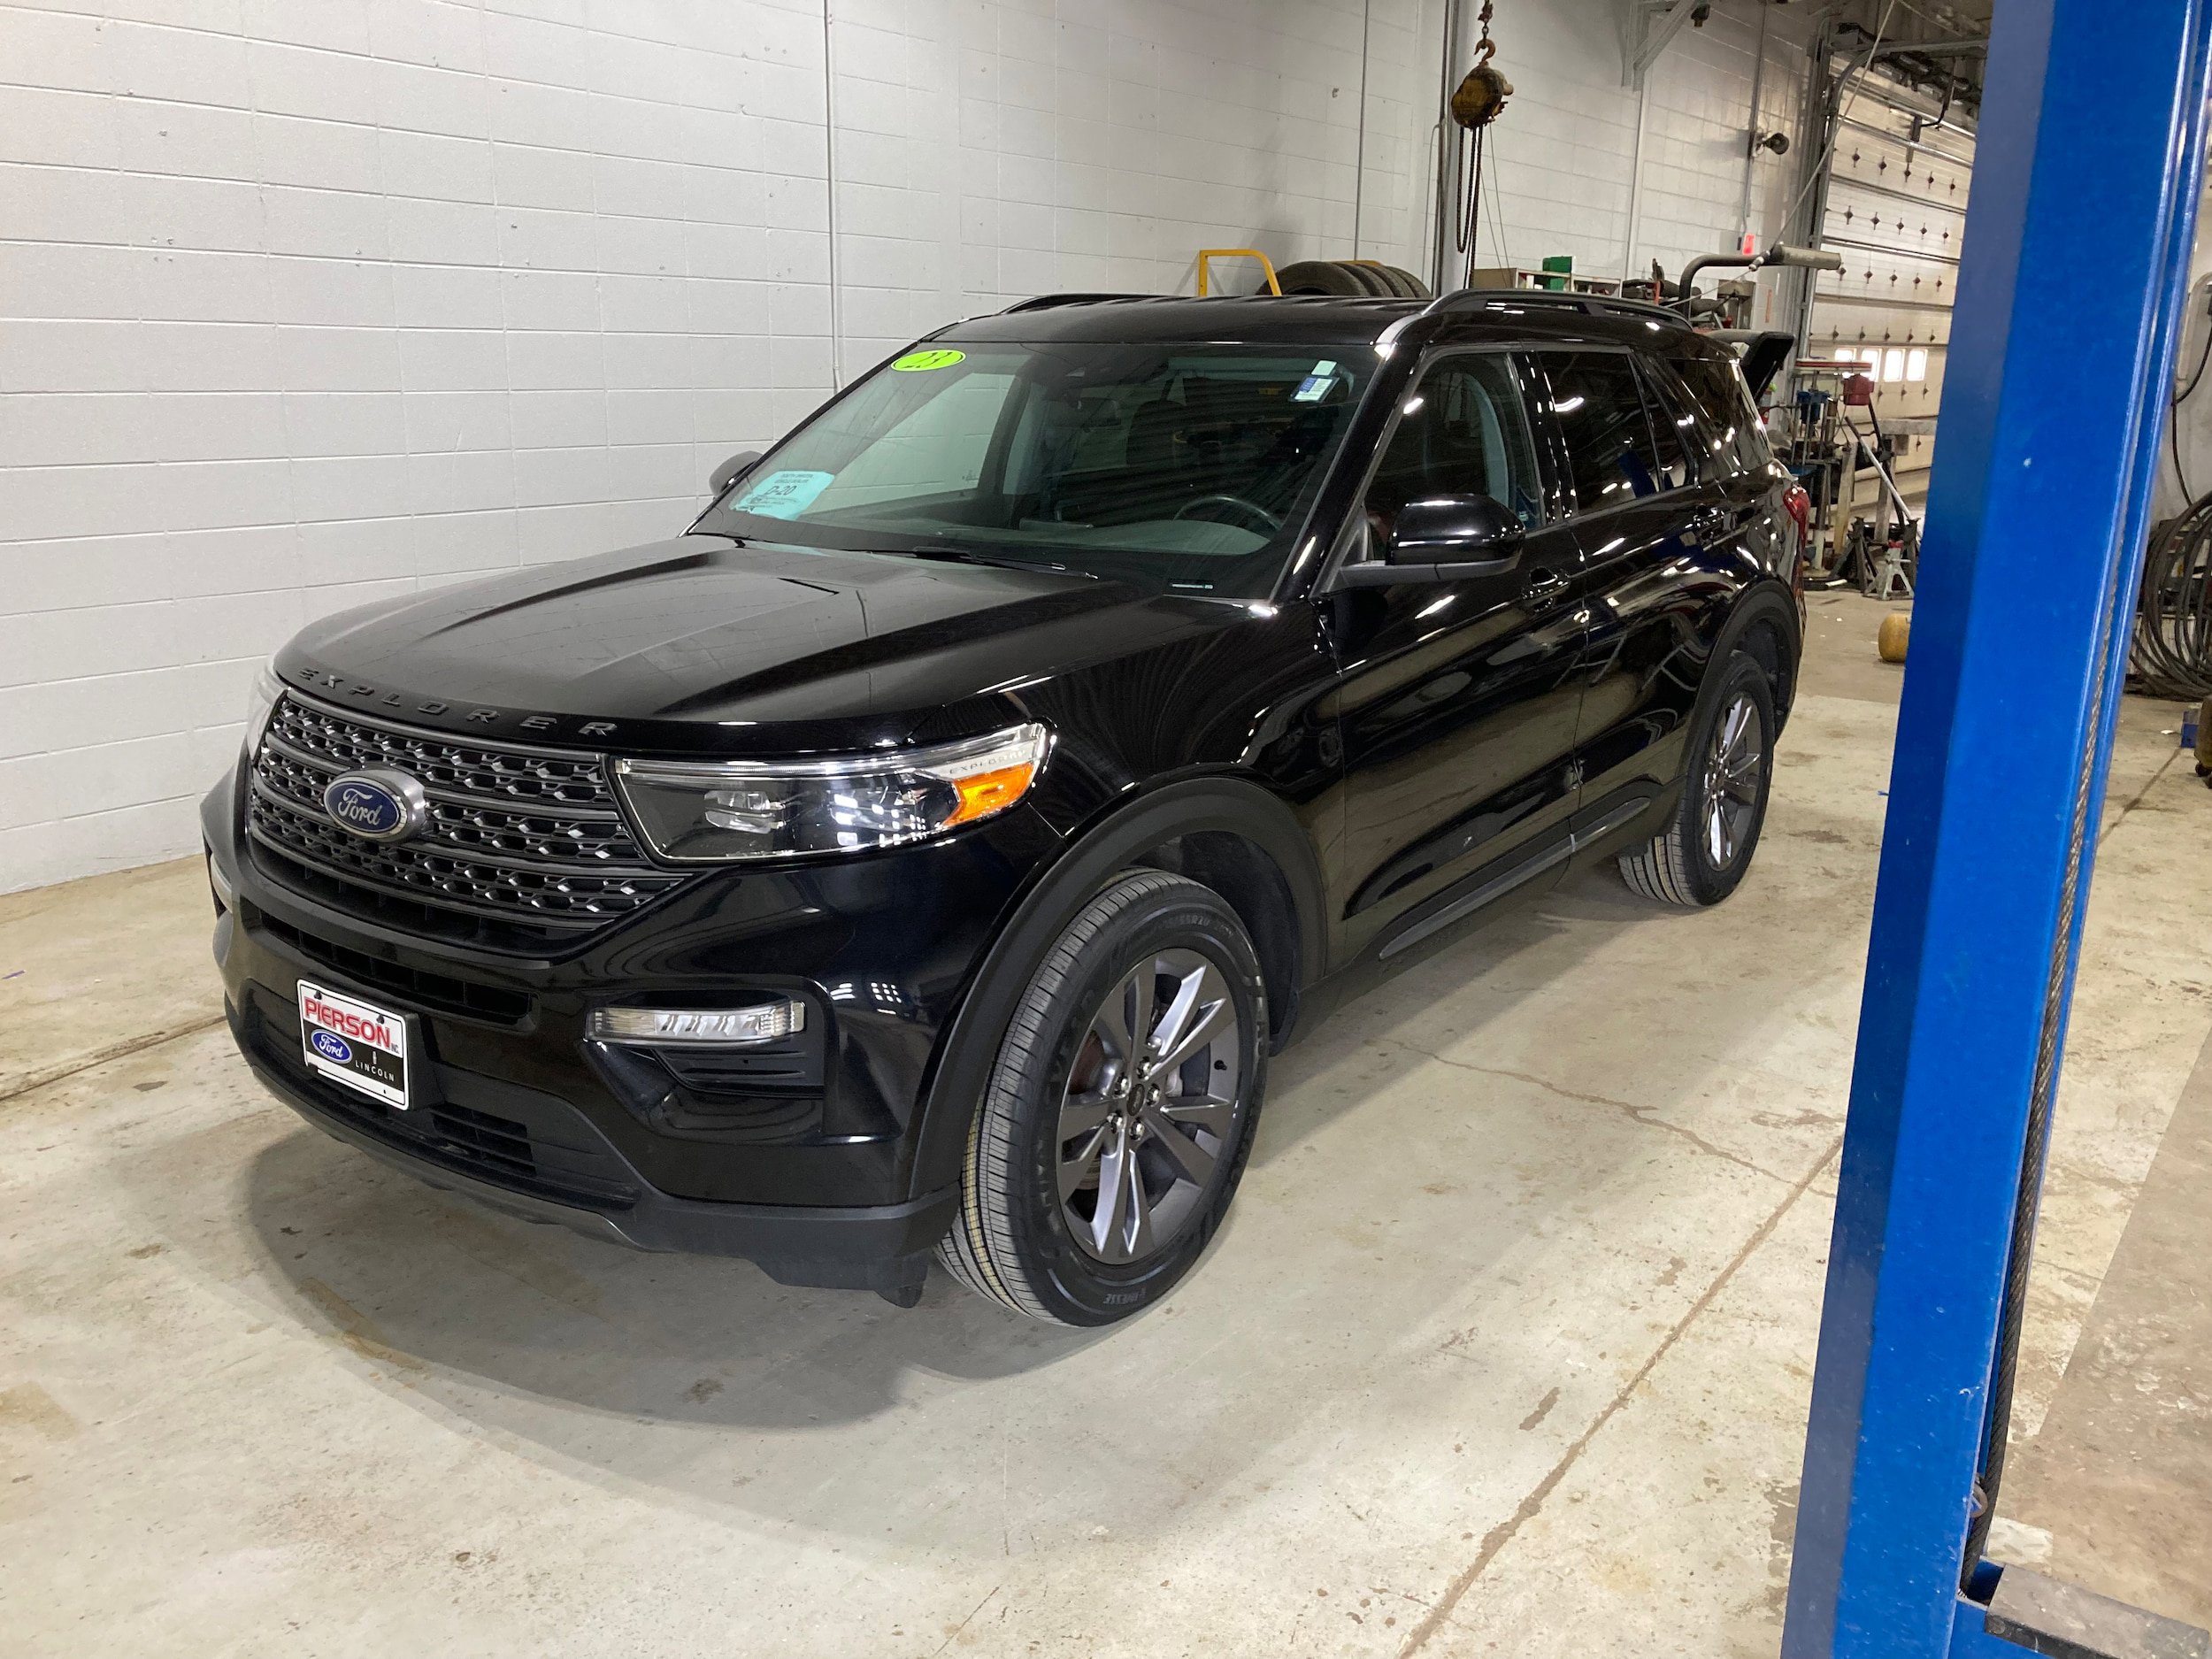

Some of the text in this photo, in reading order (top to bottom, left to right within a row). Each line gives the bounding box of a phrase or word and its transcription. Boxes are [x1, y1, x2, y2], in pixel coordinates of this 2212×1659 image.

[764, 485, 798, 495] D-20
[298, 666, 618, 738] EXPLORER
[337, 787, 383, 826] Ford
[303, 995, 392, 1050] PIERSON
[319, 1033, 344, 1058] Ford
[355, 1060, 395, 1082] LINCOLN
